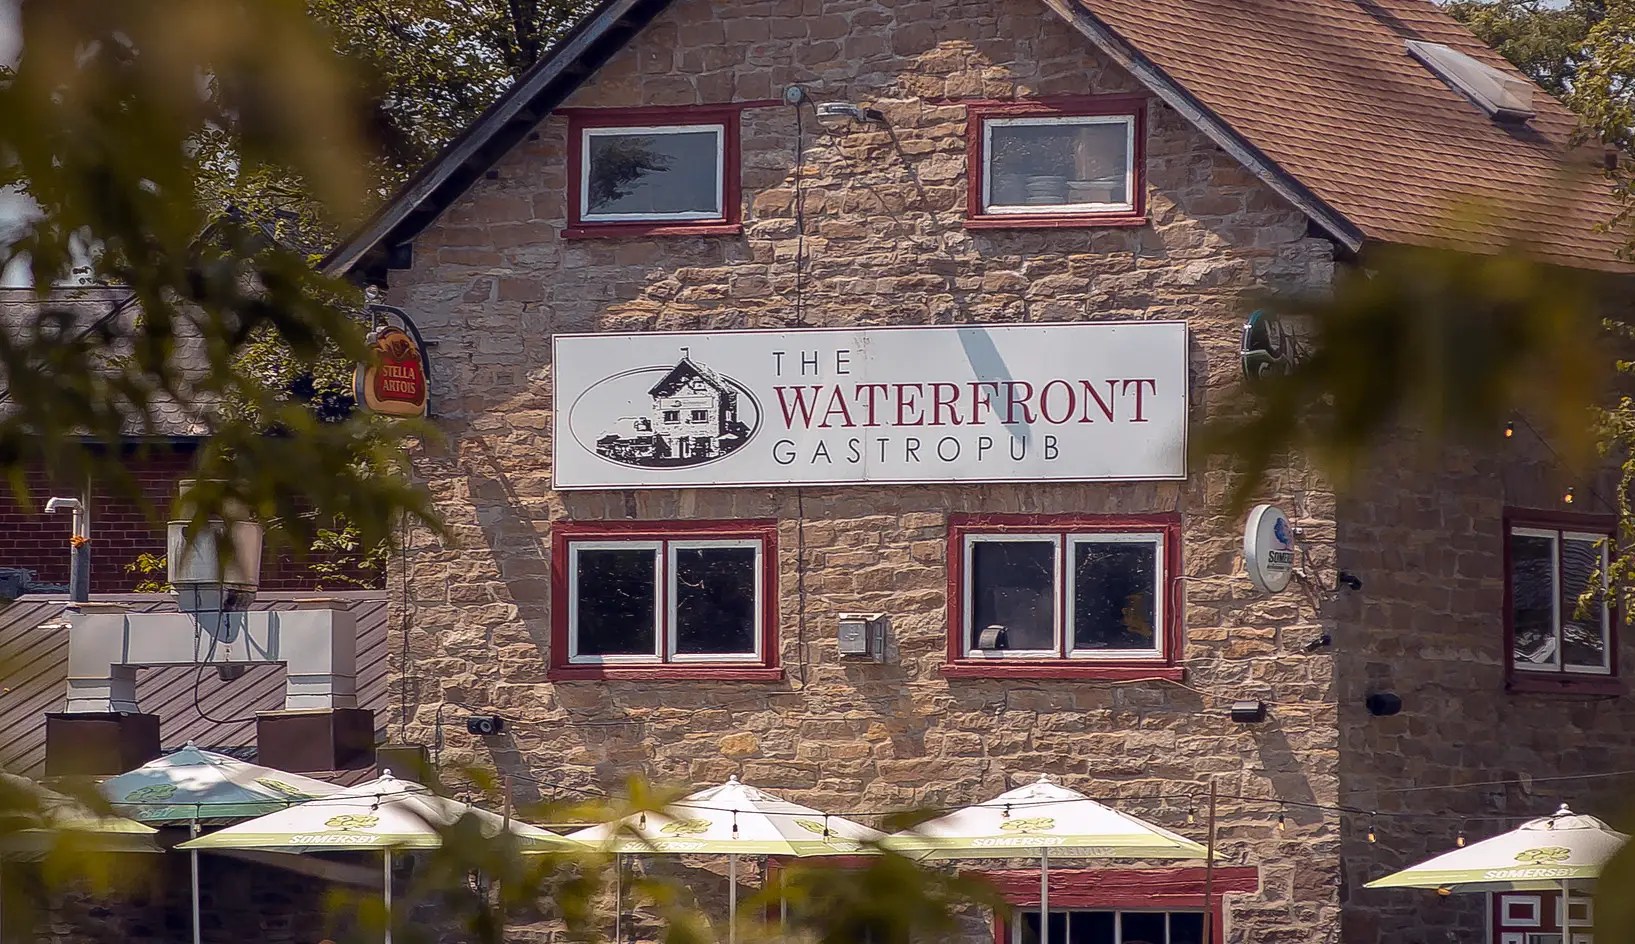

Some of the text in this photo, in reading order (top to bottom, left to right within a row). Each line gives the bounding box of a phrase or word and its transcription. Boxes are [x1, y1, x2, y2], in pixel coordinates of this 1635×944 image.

[772, 350, 851, 377] THE
[383, 365, 416, 380] STELLA
[383, 379, 416, 394] ARTOIS
[772, 379, 1157, 430] WATERFRONT
[772, 435, 1060, 465] GASTROPUB
[288, 834, 381, 845] SOMERSBY
[970, 837, 1067, 847] SOMERSBY
[1483, 868, 1580, 879] SOMERSBY
